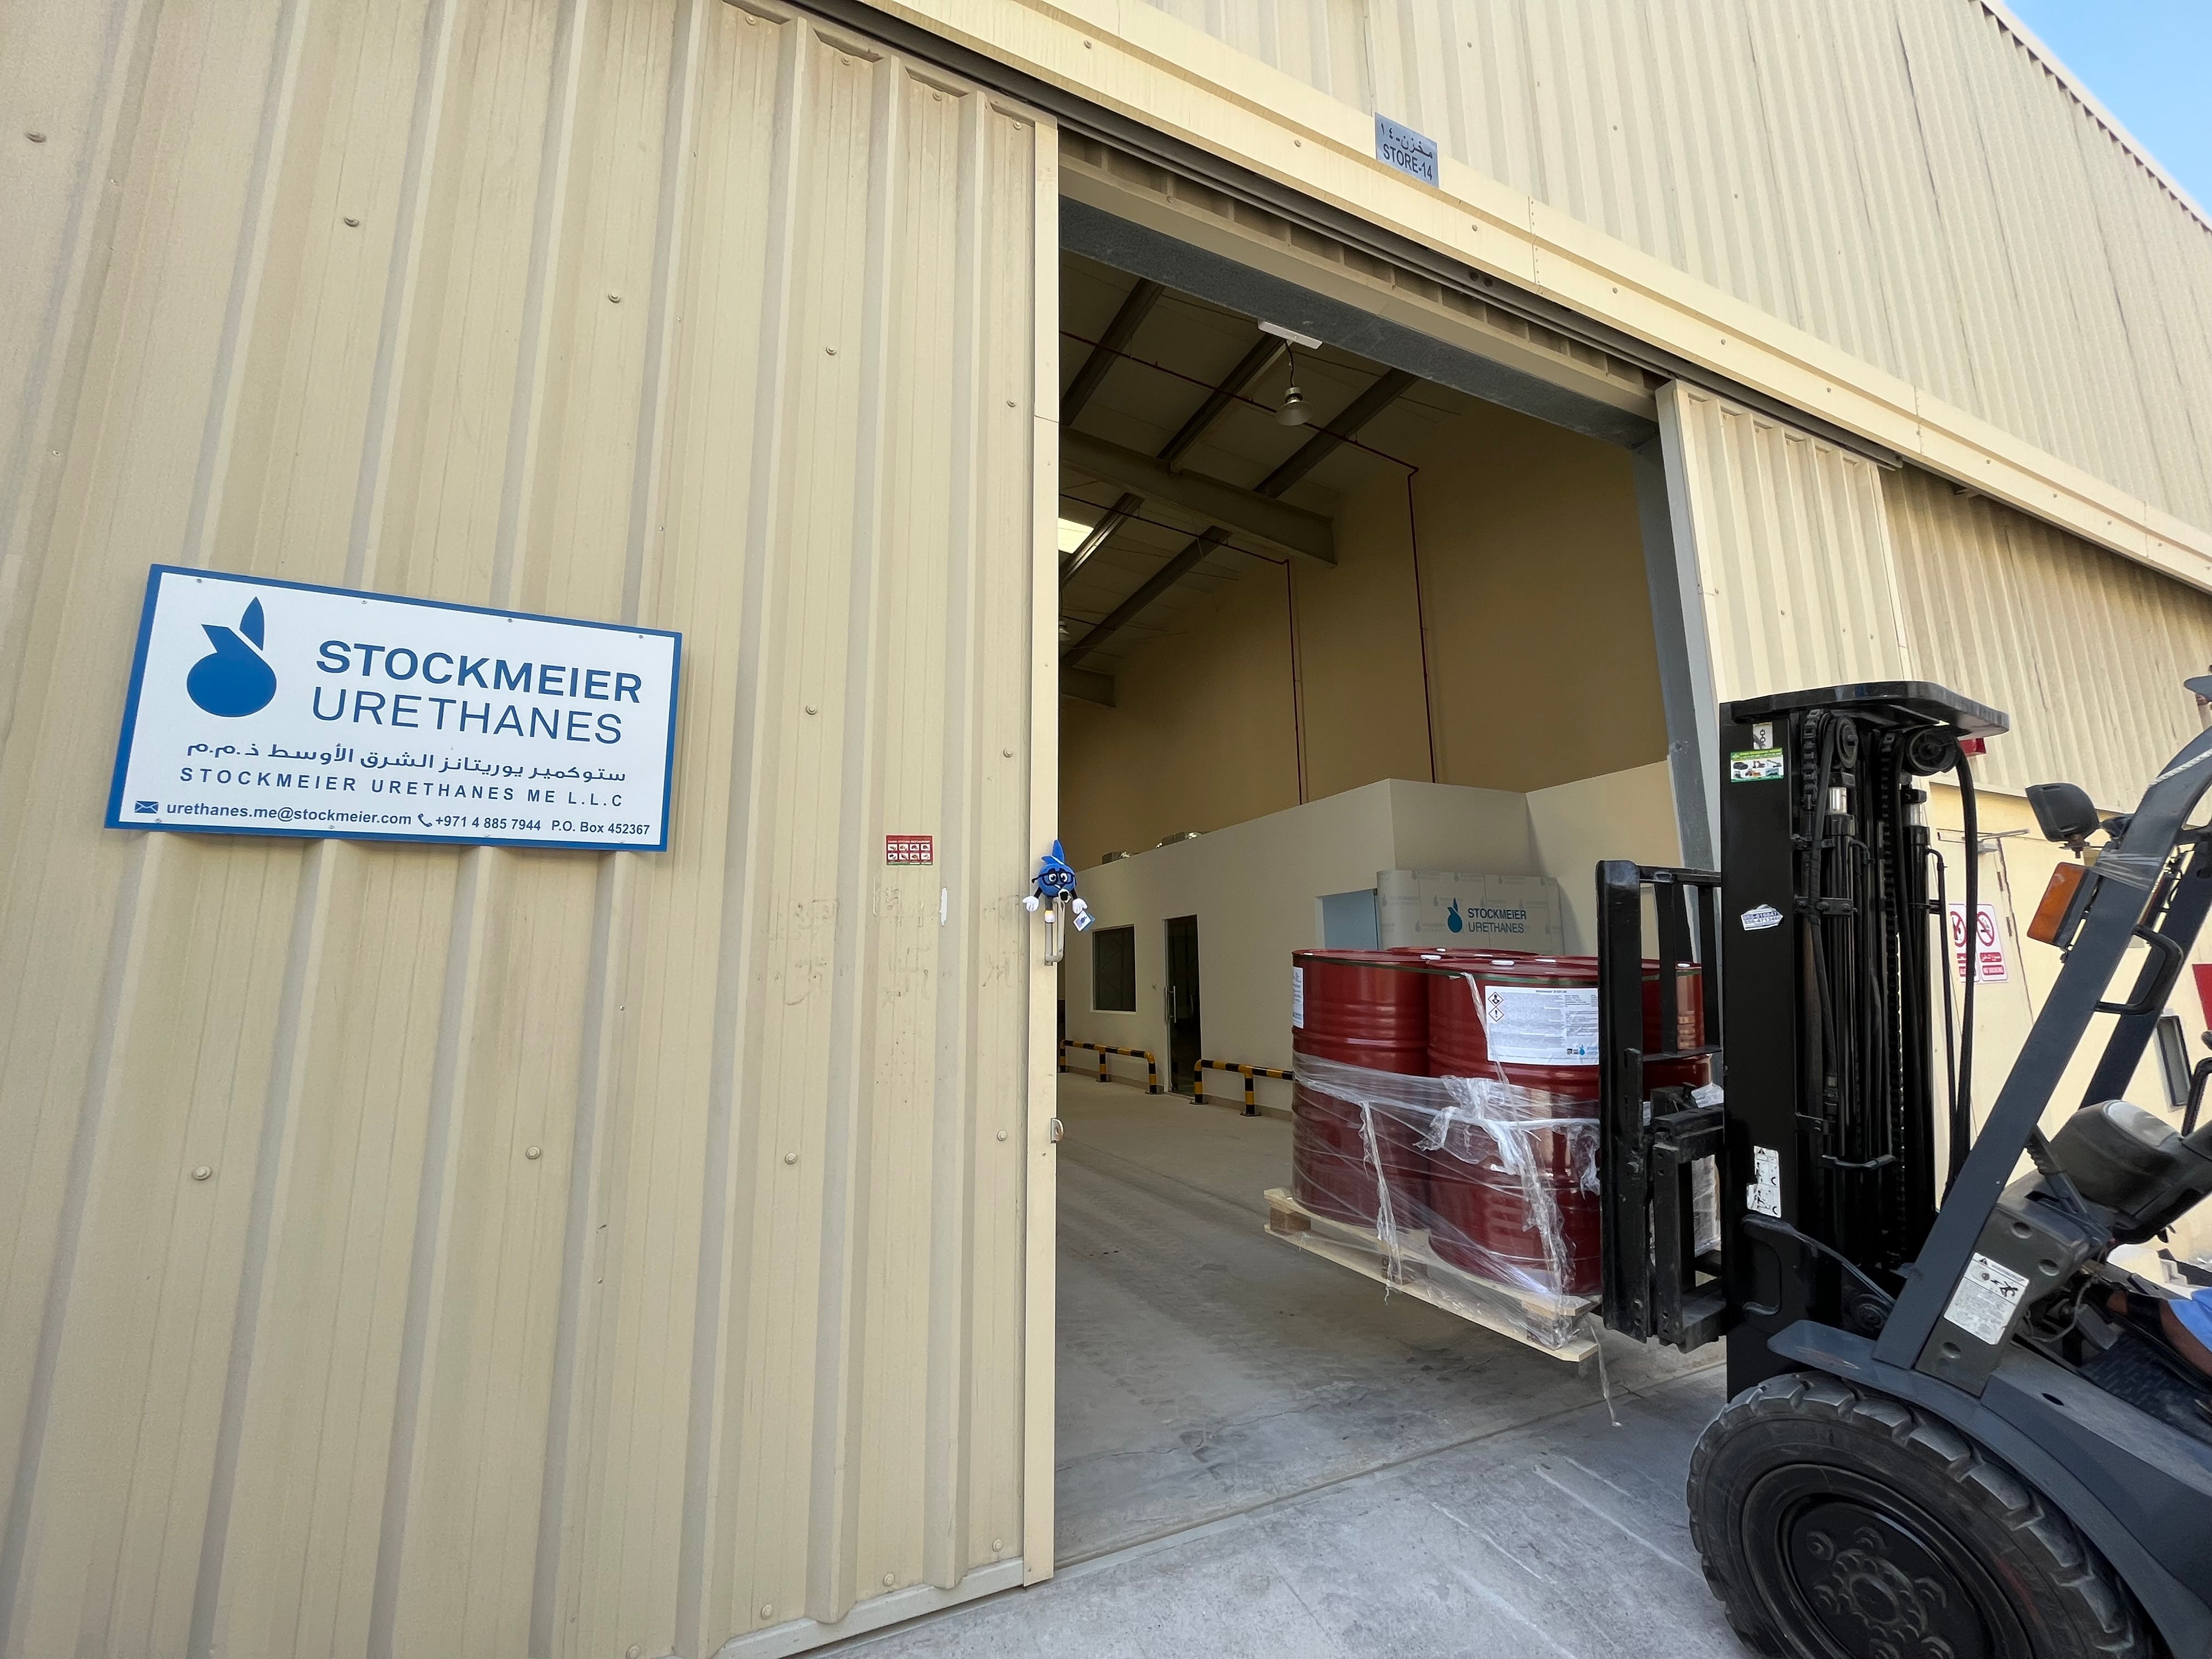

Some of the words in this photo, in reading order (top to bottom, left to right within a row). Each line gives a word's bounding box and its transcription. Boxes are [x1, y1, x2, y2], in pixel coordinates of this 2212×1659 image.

[1383, 143, 1433, 180] STORE-14
[316, 640, 642, 703] STOCKMEIER
[313, 686, 622, 744] URETHANES
[267, 743, 354, 765] الأوسط
[360, 752, 434, 774] الشرق
[438, 757, 523, 777] يوريتانز
[528, 766, 625, 783] ستوكمير
[180, 767, 356, 792] STOCKMEIER
[371, 779, 514, 800] URETHANES
[527, 789, 555, 803] ME
[568, 792, 622, 807] L.L.C
[167, 803, 411, 825] urethanes.me@stockmeier.com
[435, 815, 466, 827] +971
[471, 816, 479, 828] 4
[483, 817, 507, 830] 885
[511, 819, 541, 831] 7944
[551, 820, 575, 832] P.O.
[580, 821, 605, 833] Box
[607, 823, 650, 835] 452367
[1468, 908, 1527, 919] STOCKMEIER
[1468, 922, 1525, 934] URETHANES
